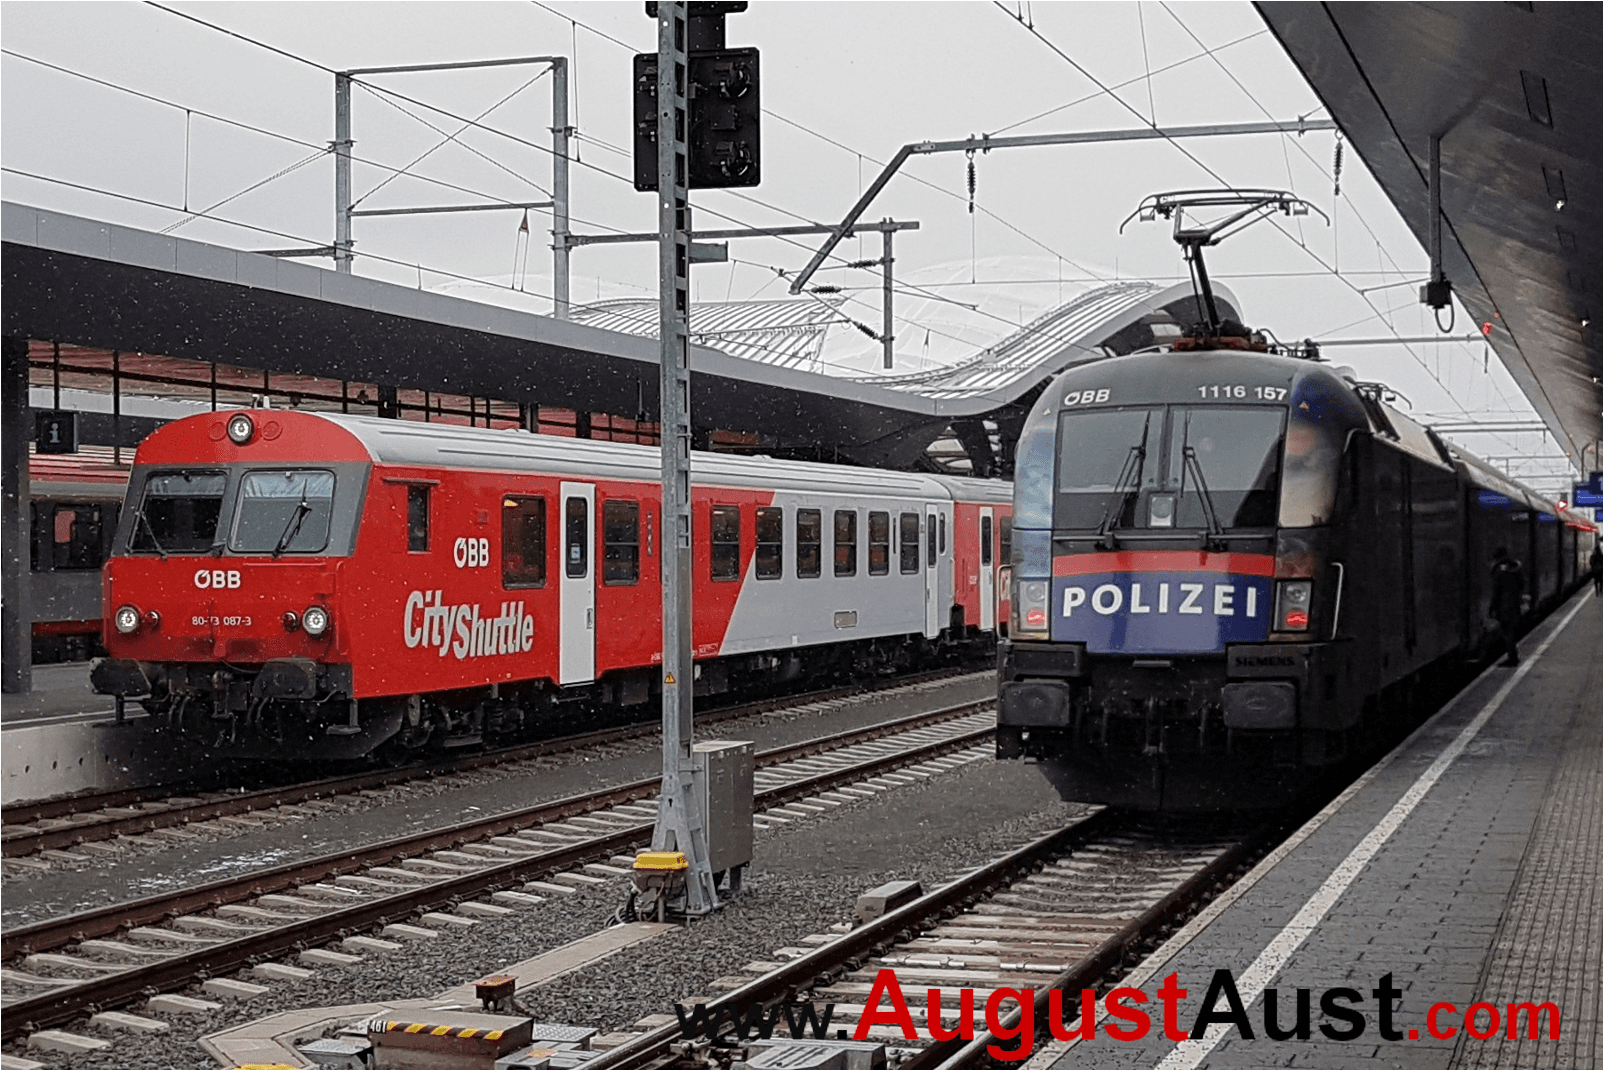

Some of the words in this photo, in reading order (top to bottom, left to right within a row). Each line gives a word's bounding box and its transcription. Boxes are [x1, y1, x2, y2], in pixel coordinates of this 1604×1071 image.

[1198, 385, 1246, 399] 1116
[1254, 386, 1287, 401] 157
[1062, 583, 1257, 618] POLIZEI
[223, 616, 252, 626] 087-3
[403, 589, 534, 660] CityShuttle
